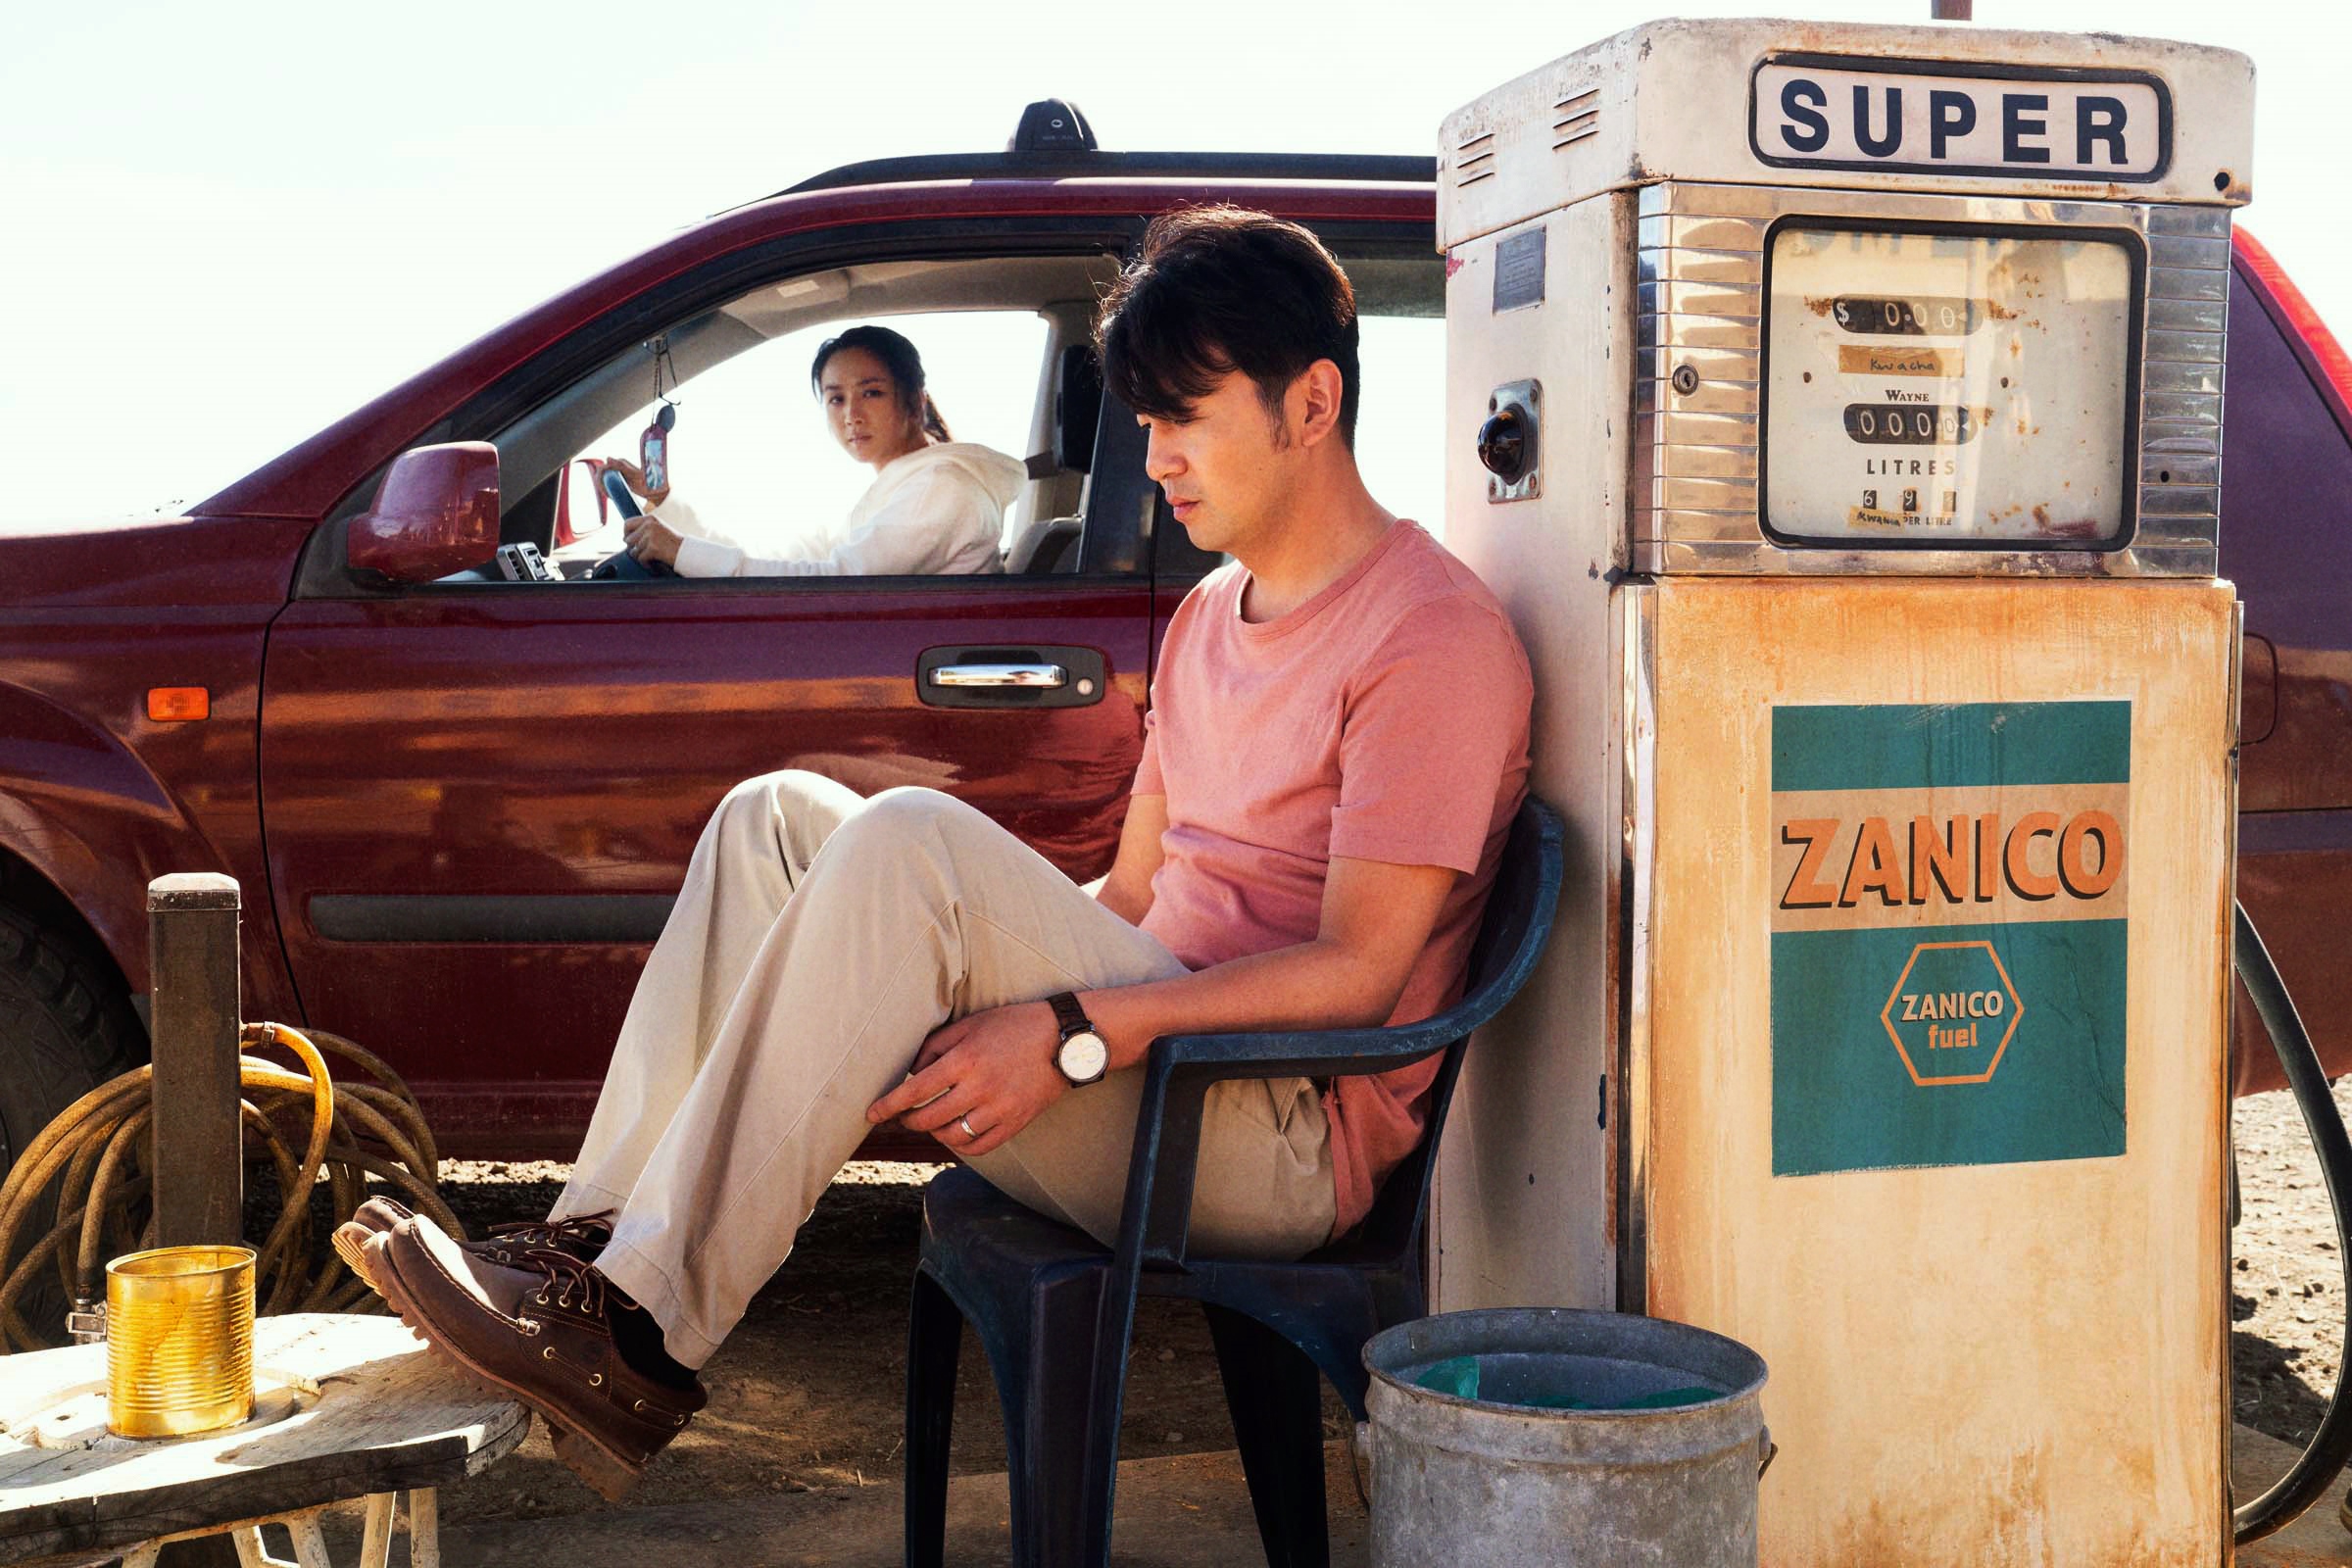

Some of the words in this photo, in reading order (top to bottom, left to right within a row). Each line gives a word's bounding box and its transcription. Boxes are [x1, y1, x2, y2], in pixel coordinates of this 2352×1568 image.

[1780, 79, 2129, 165] SUPER
[1836, 302, 1849, 326] $
[1866, 459, 1956, 475] LITRES
[1779, 809, 2125, 909] ZANICO
[1900, 990, 2004, 1022] ZANICO
[1928, 1022, 1979, 1050] fuel
